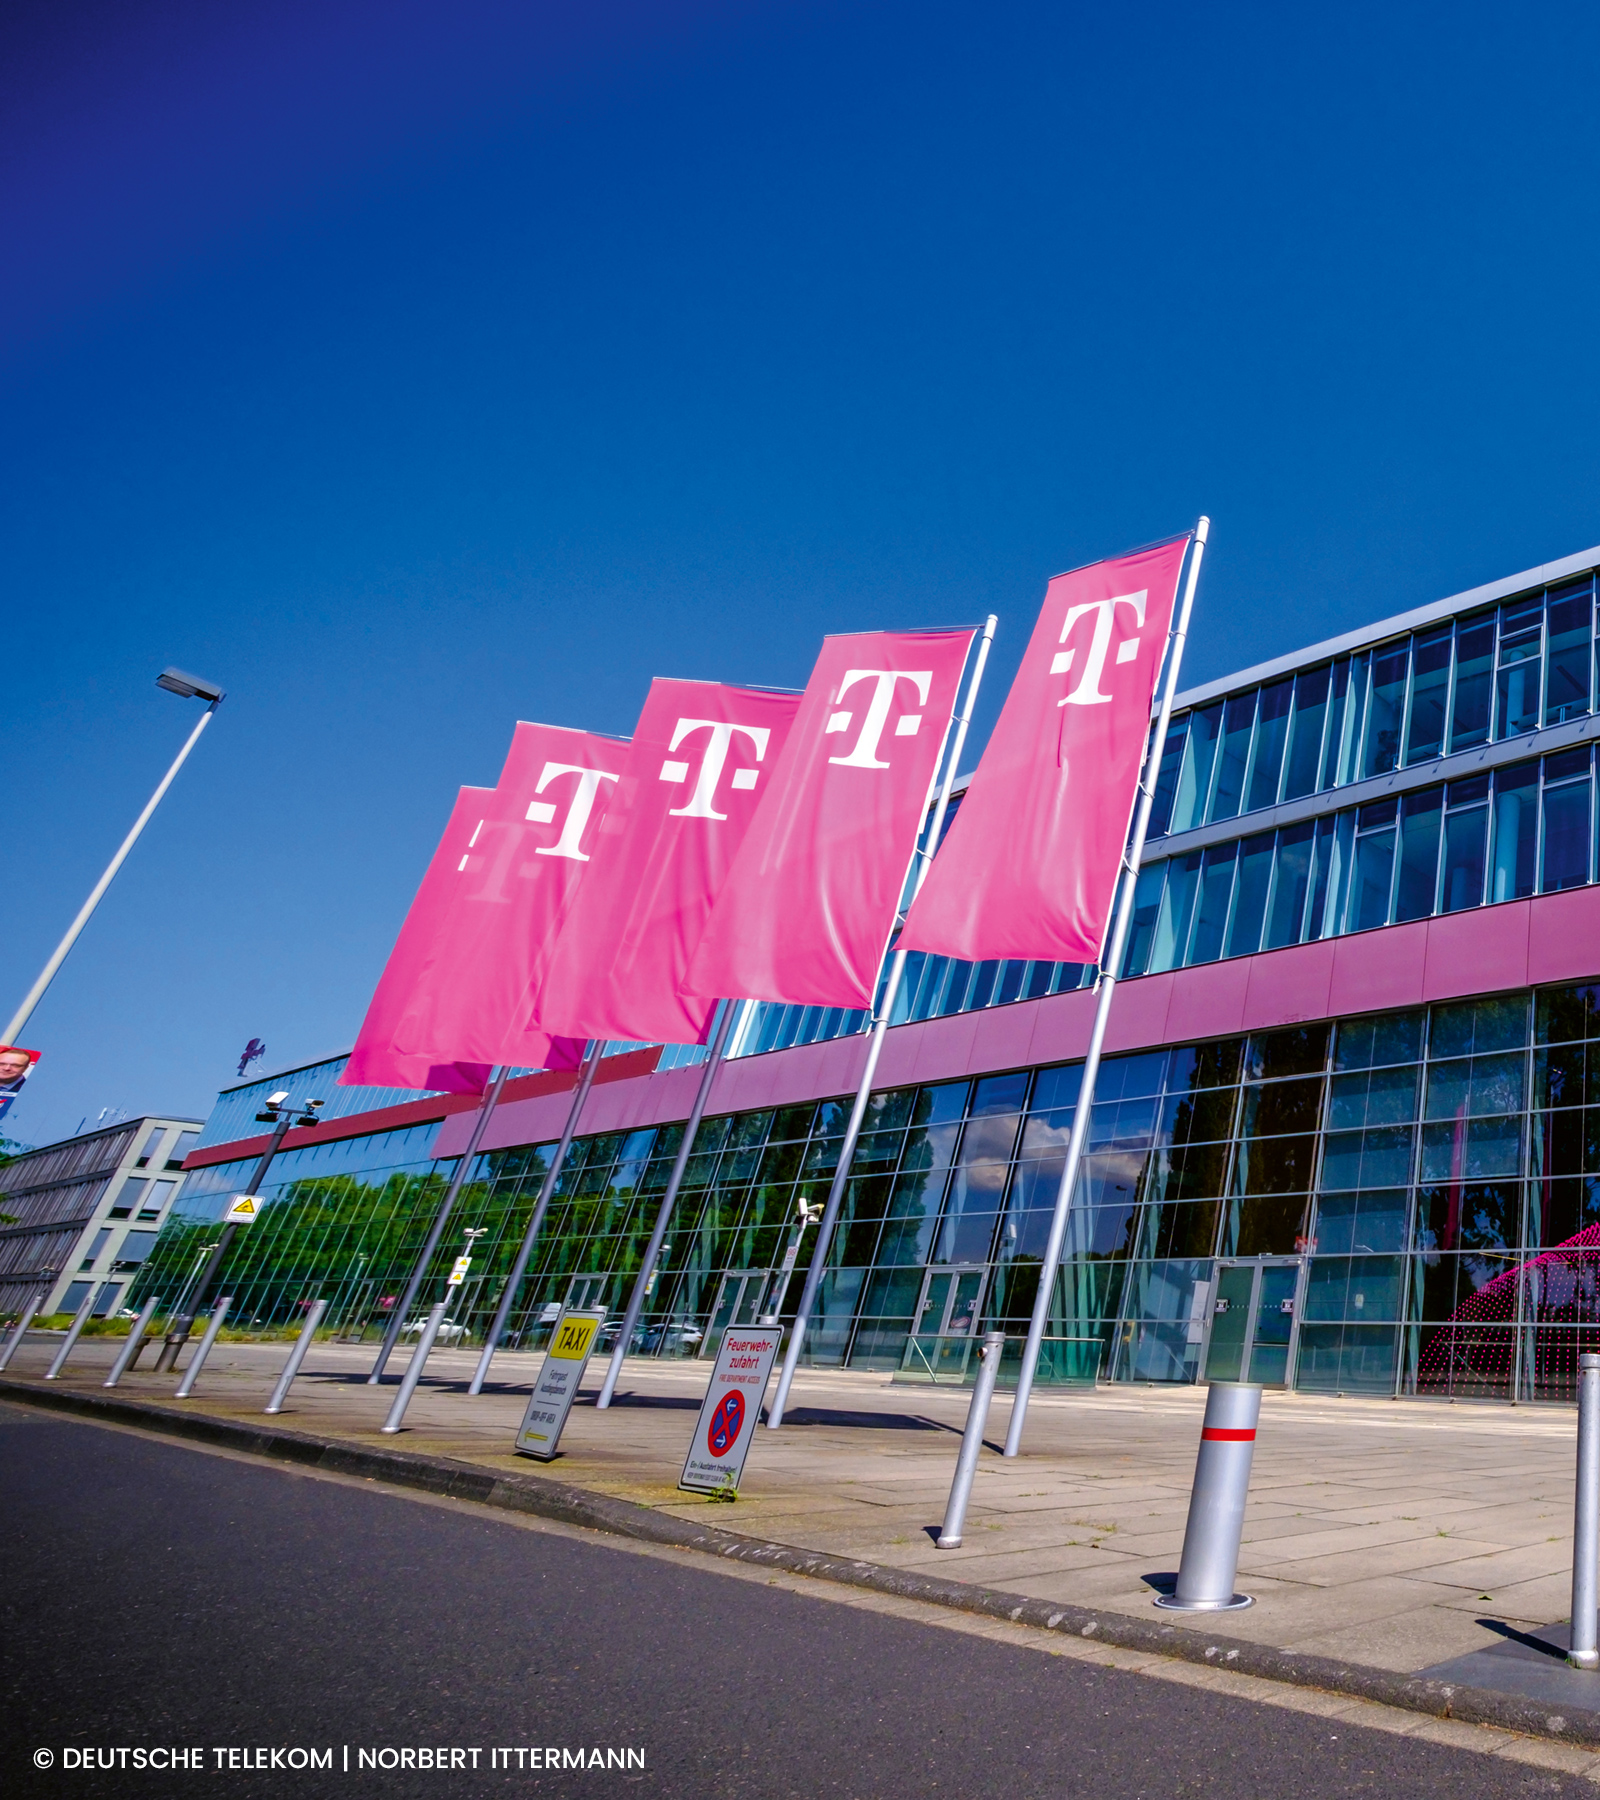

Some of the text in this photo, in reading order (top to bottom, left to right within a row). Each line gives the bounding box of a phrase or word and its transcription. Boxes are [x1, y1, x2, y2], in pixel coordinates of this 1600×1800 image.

[1049, 588, 1149, 708] T
[824, 669, 933, 769] T
[658, 717, 771, 821] T
[559, 1326, 591, 1351] TAXI
[726, 1337, 773, 1352] Feuerwehr-
[729, 1355, 760, 1369] zufahrt
